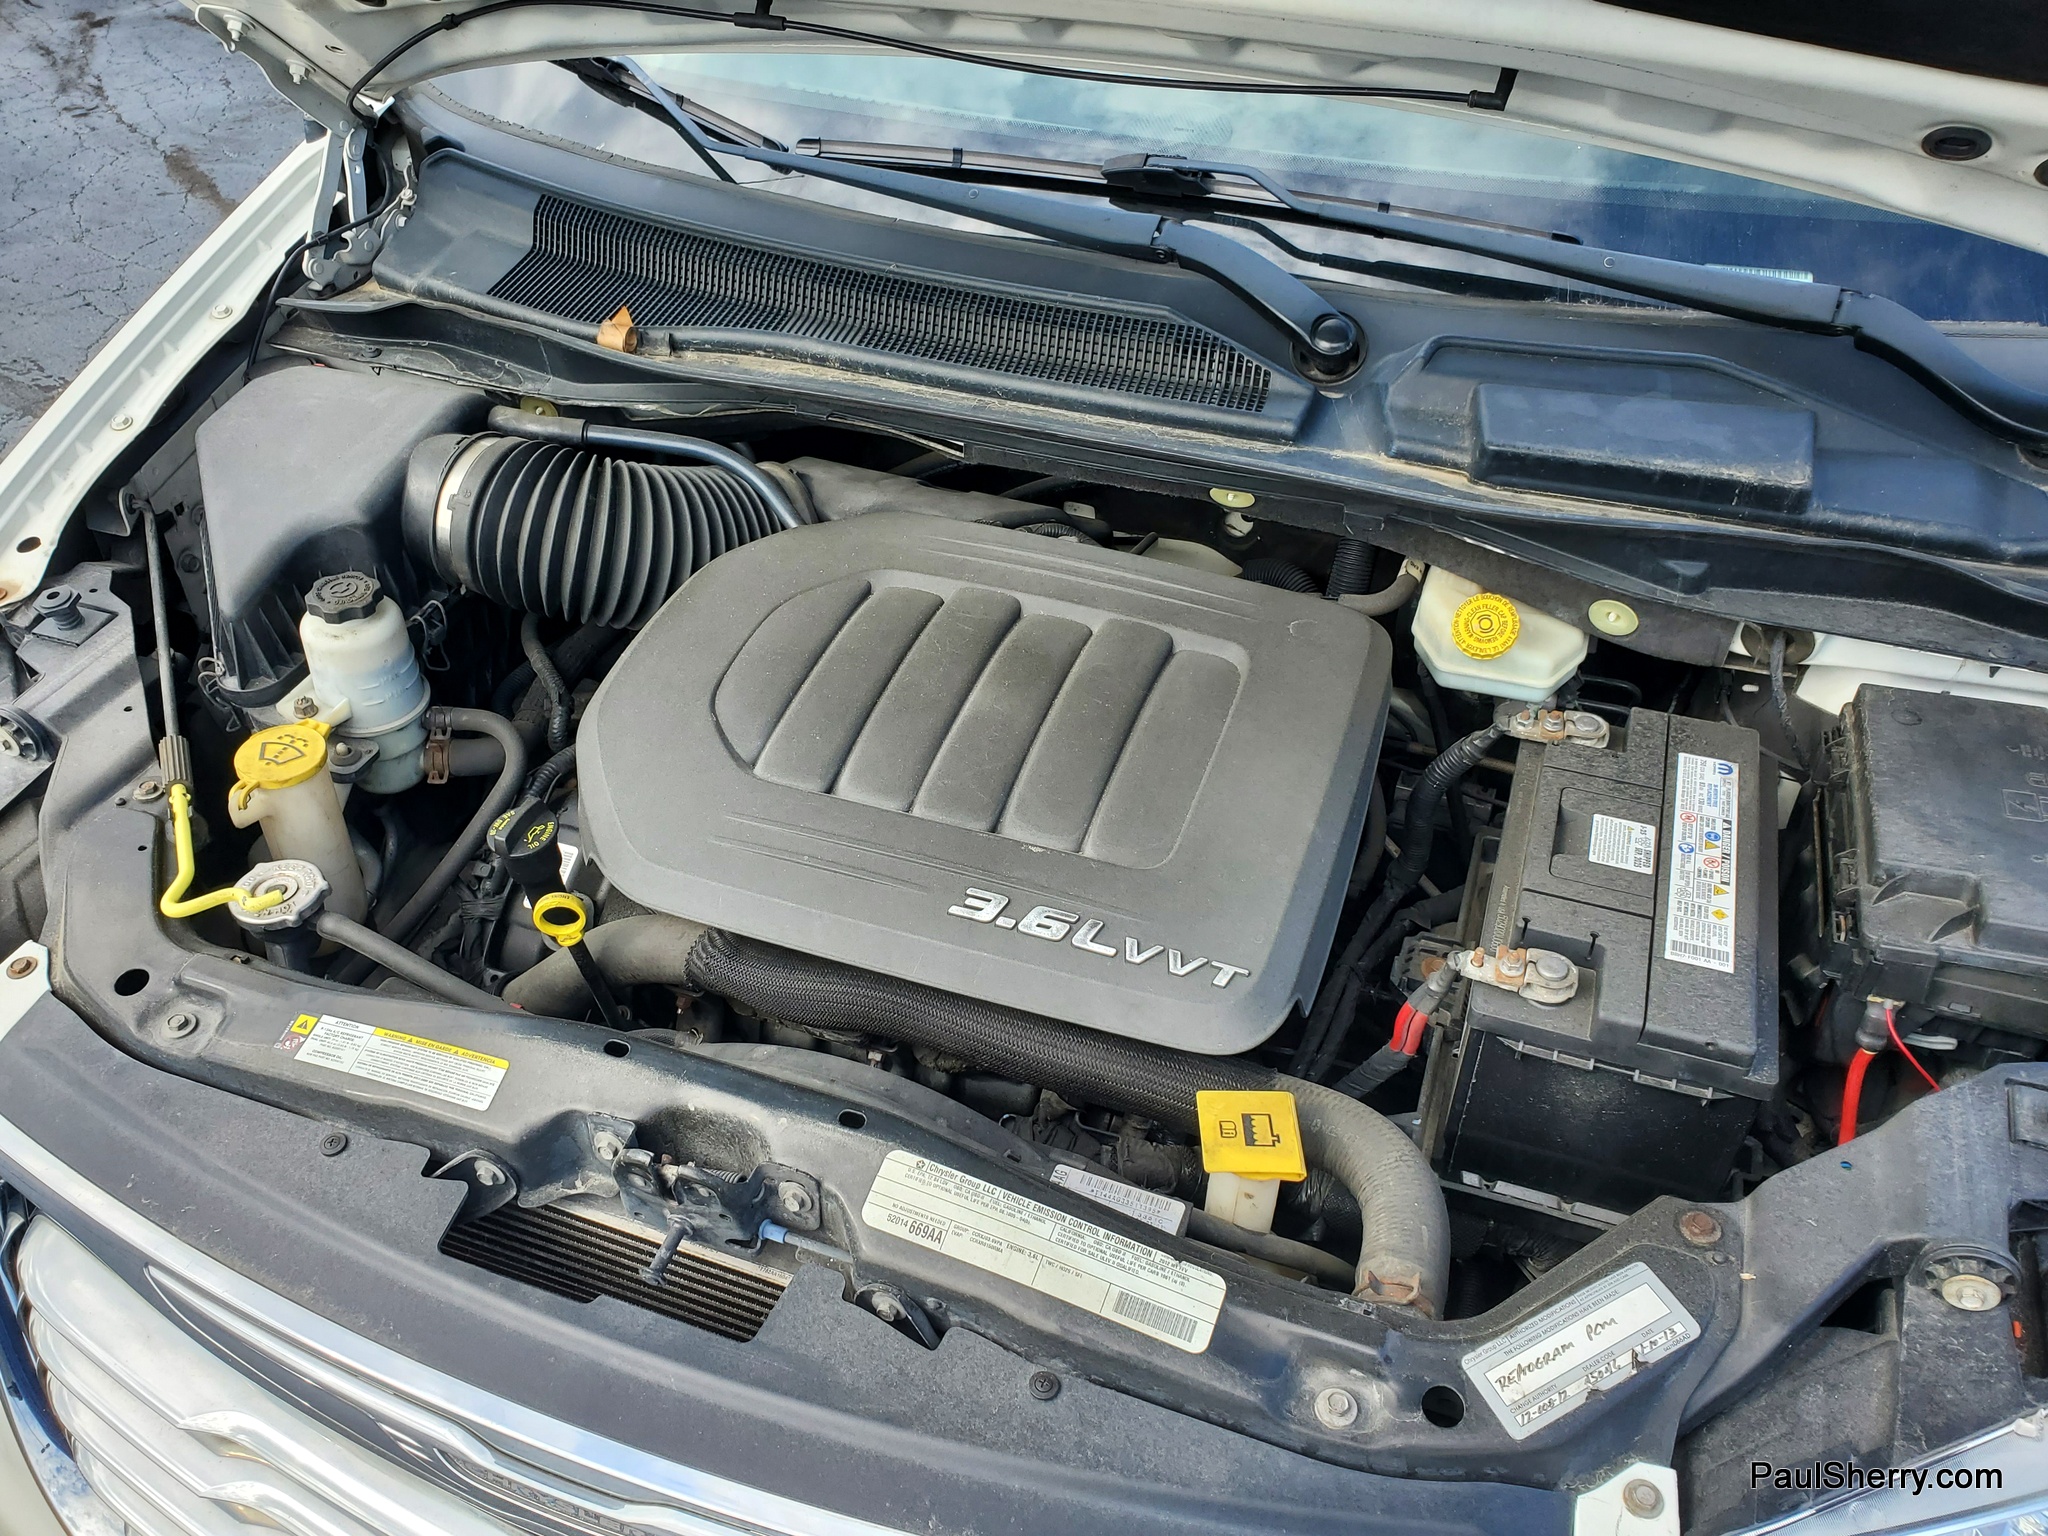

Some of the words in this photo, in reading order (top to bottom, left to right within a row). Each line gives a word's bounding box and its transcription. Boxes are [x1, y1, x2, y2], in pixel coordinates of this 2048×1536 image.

[540, 821, 555, 841] ENGINE
[1722, 829, 1731, 854] DANGER
[527, 841, 540, 849] OIL
[1642, 848, 1651, 868] SHIPPED
[1721, 859, 1730, 882] POISON
[383, 1032, 406, 1040] WARNING
[460, 1051, 496, 1064] ADVERTENCIA
[928, 1163, 959, 1181] Chrysler
[958, 1174, 981, 1190] Group
[982, 1183, 997, 1195] LLC
[1001, 1191, 1032, 1209] VEHICLE
[1031, 1203, 1067, 1223] EMISSION
[1067, 1217, 1101, 1237] CONTROL
[1102, 1231, 1153, 1258] INFORMATION
[1144, 1260, 1167, 1272] GASOLINE
[1464, 1350, 1485, 1365] Chrysler
[1481, 1342, 1498, 1355] Group
[1494, 1336, 1507, 1346] LLC
[1508, 1319, 1539, 1339] AUTHORIZED
[1537, 1299, 1577, 1323] MODIFICATIONS
[1503, 1347, 1514, 1356] THE
[1512, 1332, 1542, 1351] FOLLOWING
[1540, 1311, 1580, 1335] MODIFICATIONS
[1578, 1303, 1593, 1314] HAVE
[1590, 1296, 1605, 1307] BEEN
[1641, 1328, 1654, 1337] DATE
[1581, 1358, 1601, 1372] DEALER
[1599, 1350, 1615, 1361] CODE
[1509, 1398, 1531, 1414] CHANGE
[1531, 1383, 1558, 1401] AUTHORITY
